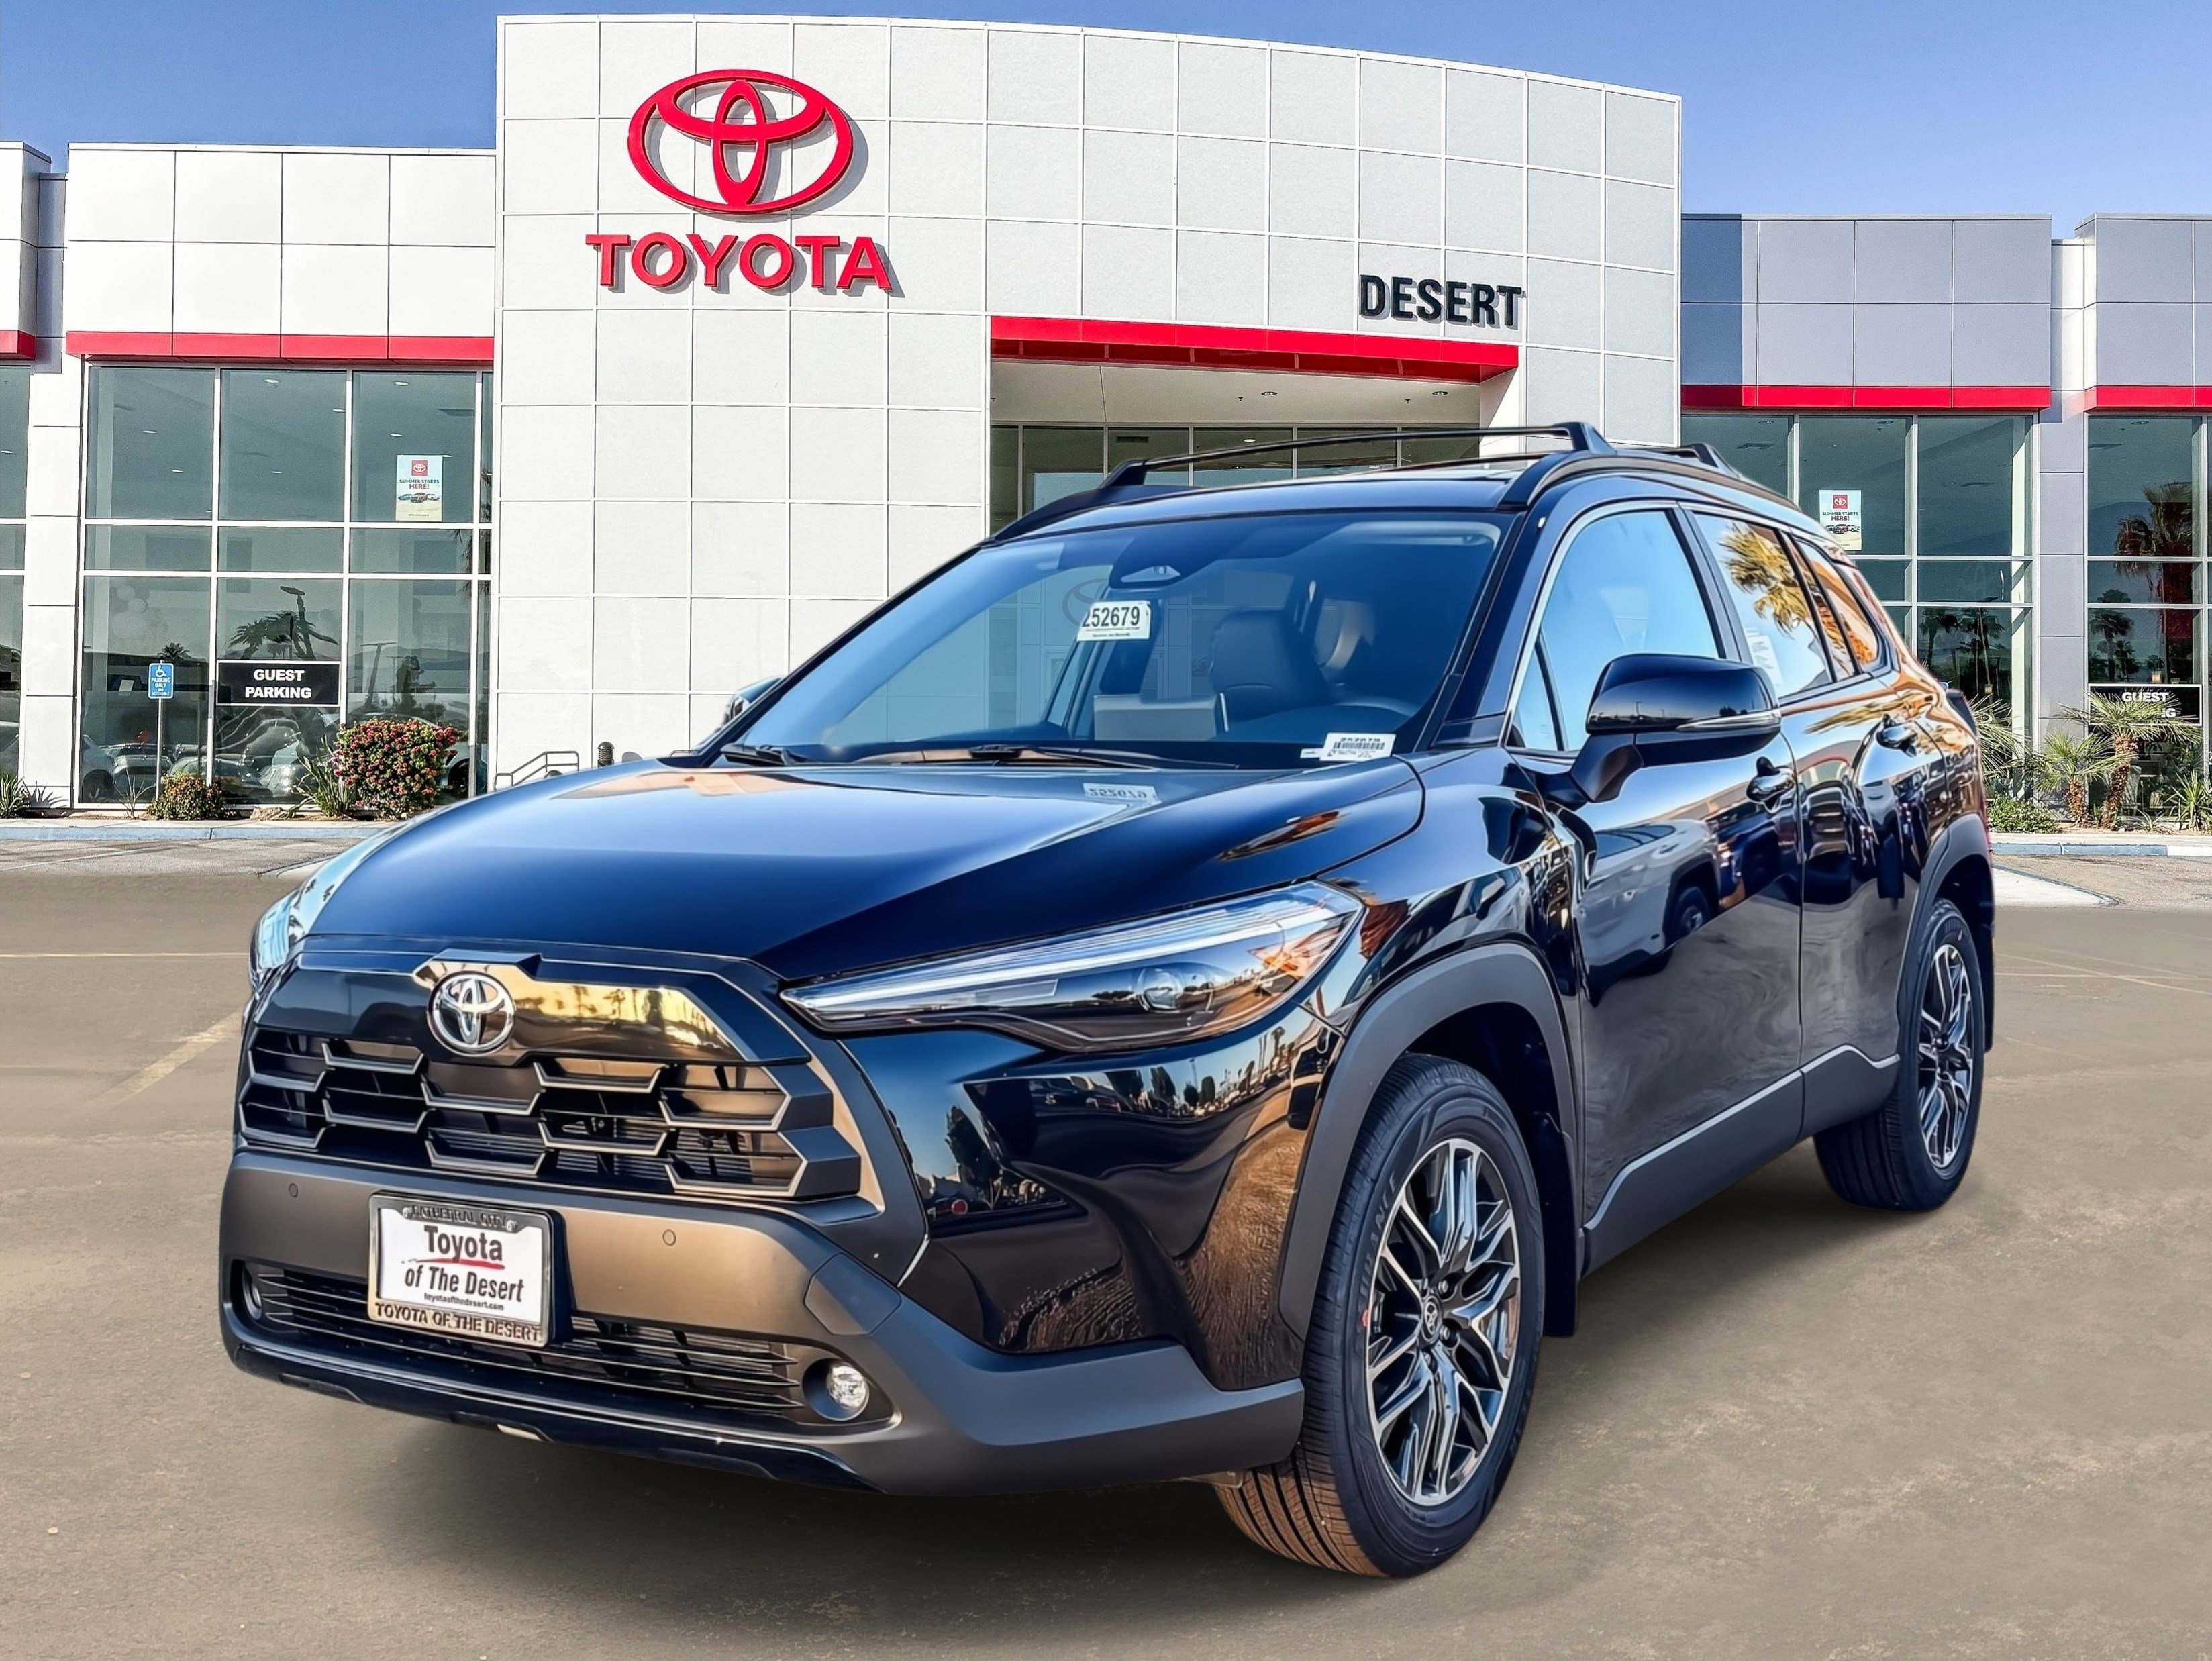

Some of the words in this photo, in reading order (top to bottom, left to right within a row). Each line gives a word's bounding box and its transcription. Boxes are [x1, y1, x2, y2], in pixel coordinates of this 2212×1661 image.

[585, 232, 893, 290] TOYOTA
[1359, 274, 1522, 327] DESERT
[245, 686, 312, 699] PARKING
[253, 668, 305, 682] GUEST
[2121, 691, 2170, 703] GUEST
[424, 1225, 503, 1263] Toyota
[405, 1264, 423, 1288] of
[429, 1266, 459, 1293] The
[465, 1271, 524, 1302] Desert
[424, 1292, 504, 1311] toyotaofthedesert.com
[375, 1302, 428, 1324] TOYOTA
[432, 1311, 454, 1327] OF
[454, 1315, 482, 1333] THE
[485, 1319, 542, 1342] DESERT
